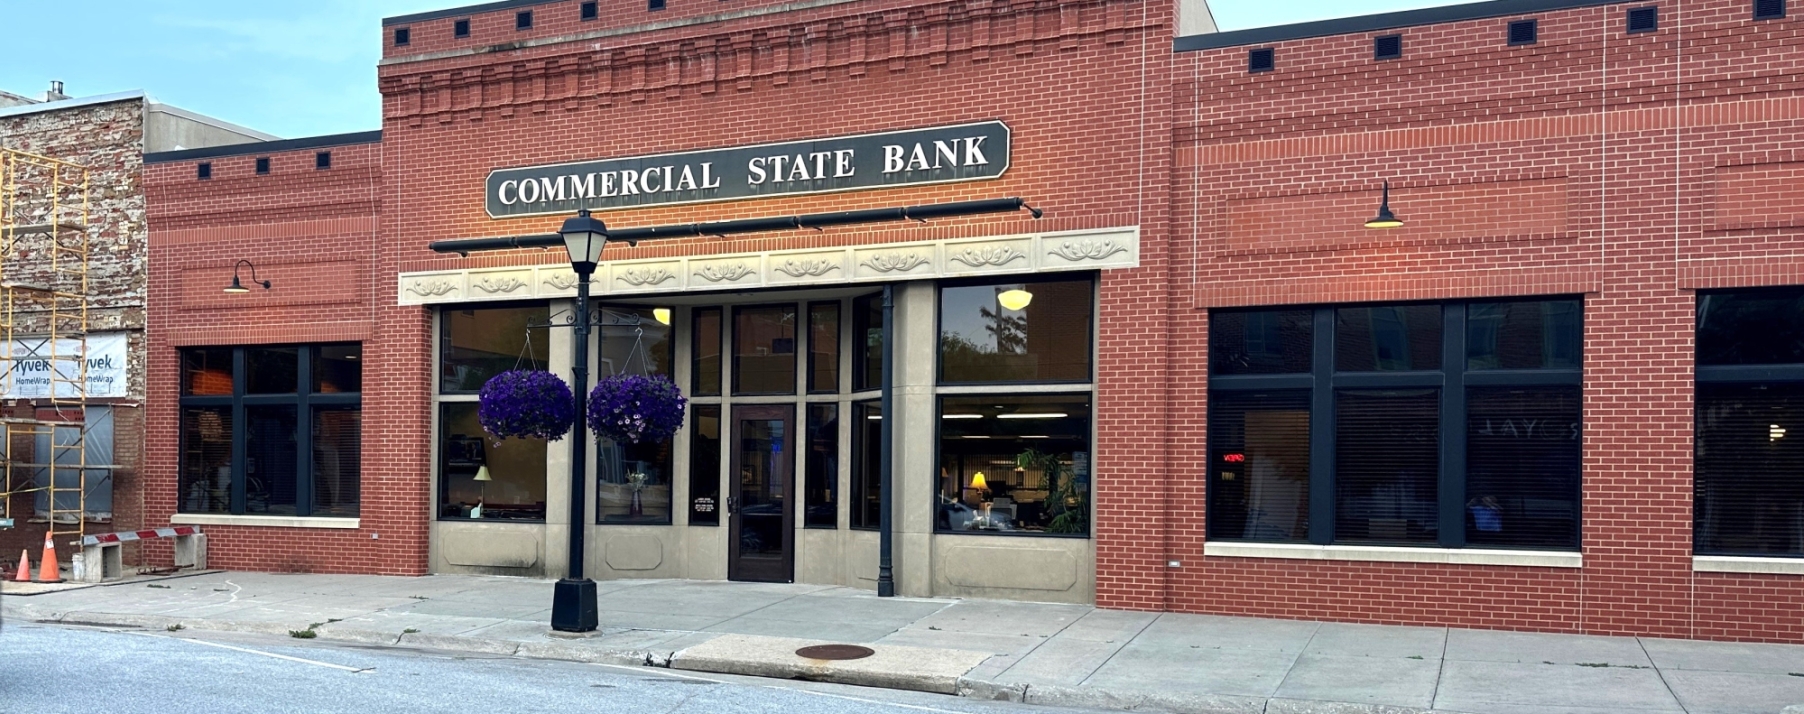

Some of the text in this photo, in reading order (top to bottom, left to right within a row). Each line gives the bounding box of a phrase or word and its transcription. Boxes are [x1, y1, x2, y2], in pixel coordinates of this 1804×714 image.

[498, 136, 989, 205] COMMERCIAL STATE BANK
[15, 359, 49, 376] Tyvek
[16, 377, 50, 386] HomeWrap
[78, 375, 113, 384] HmeWrap
